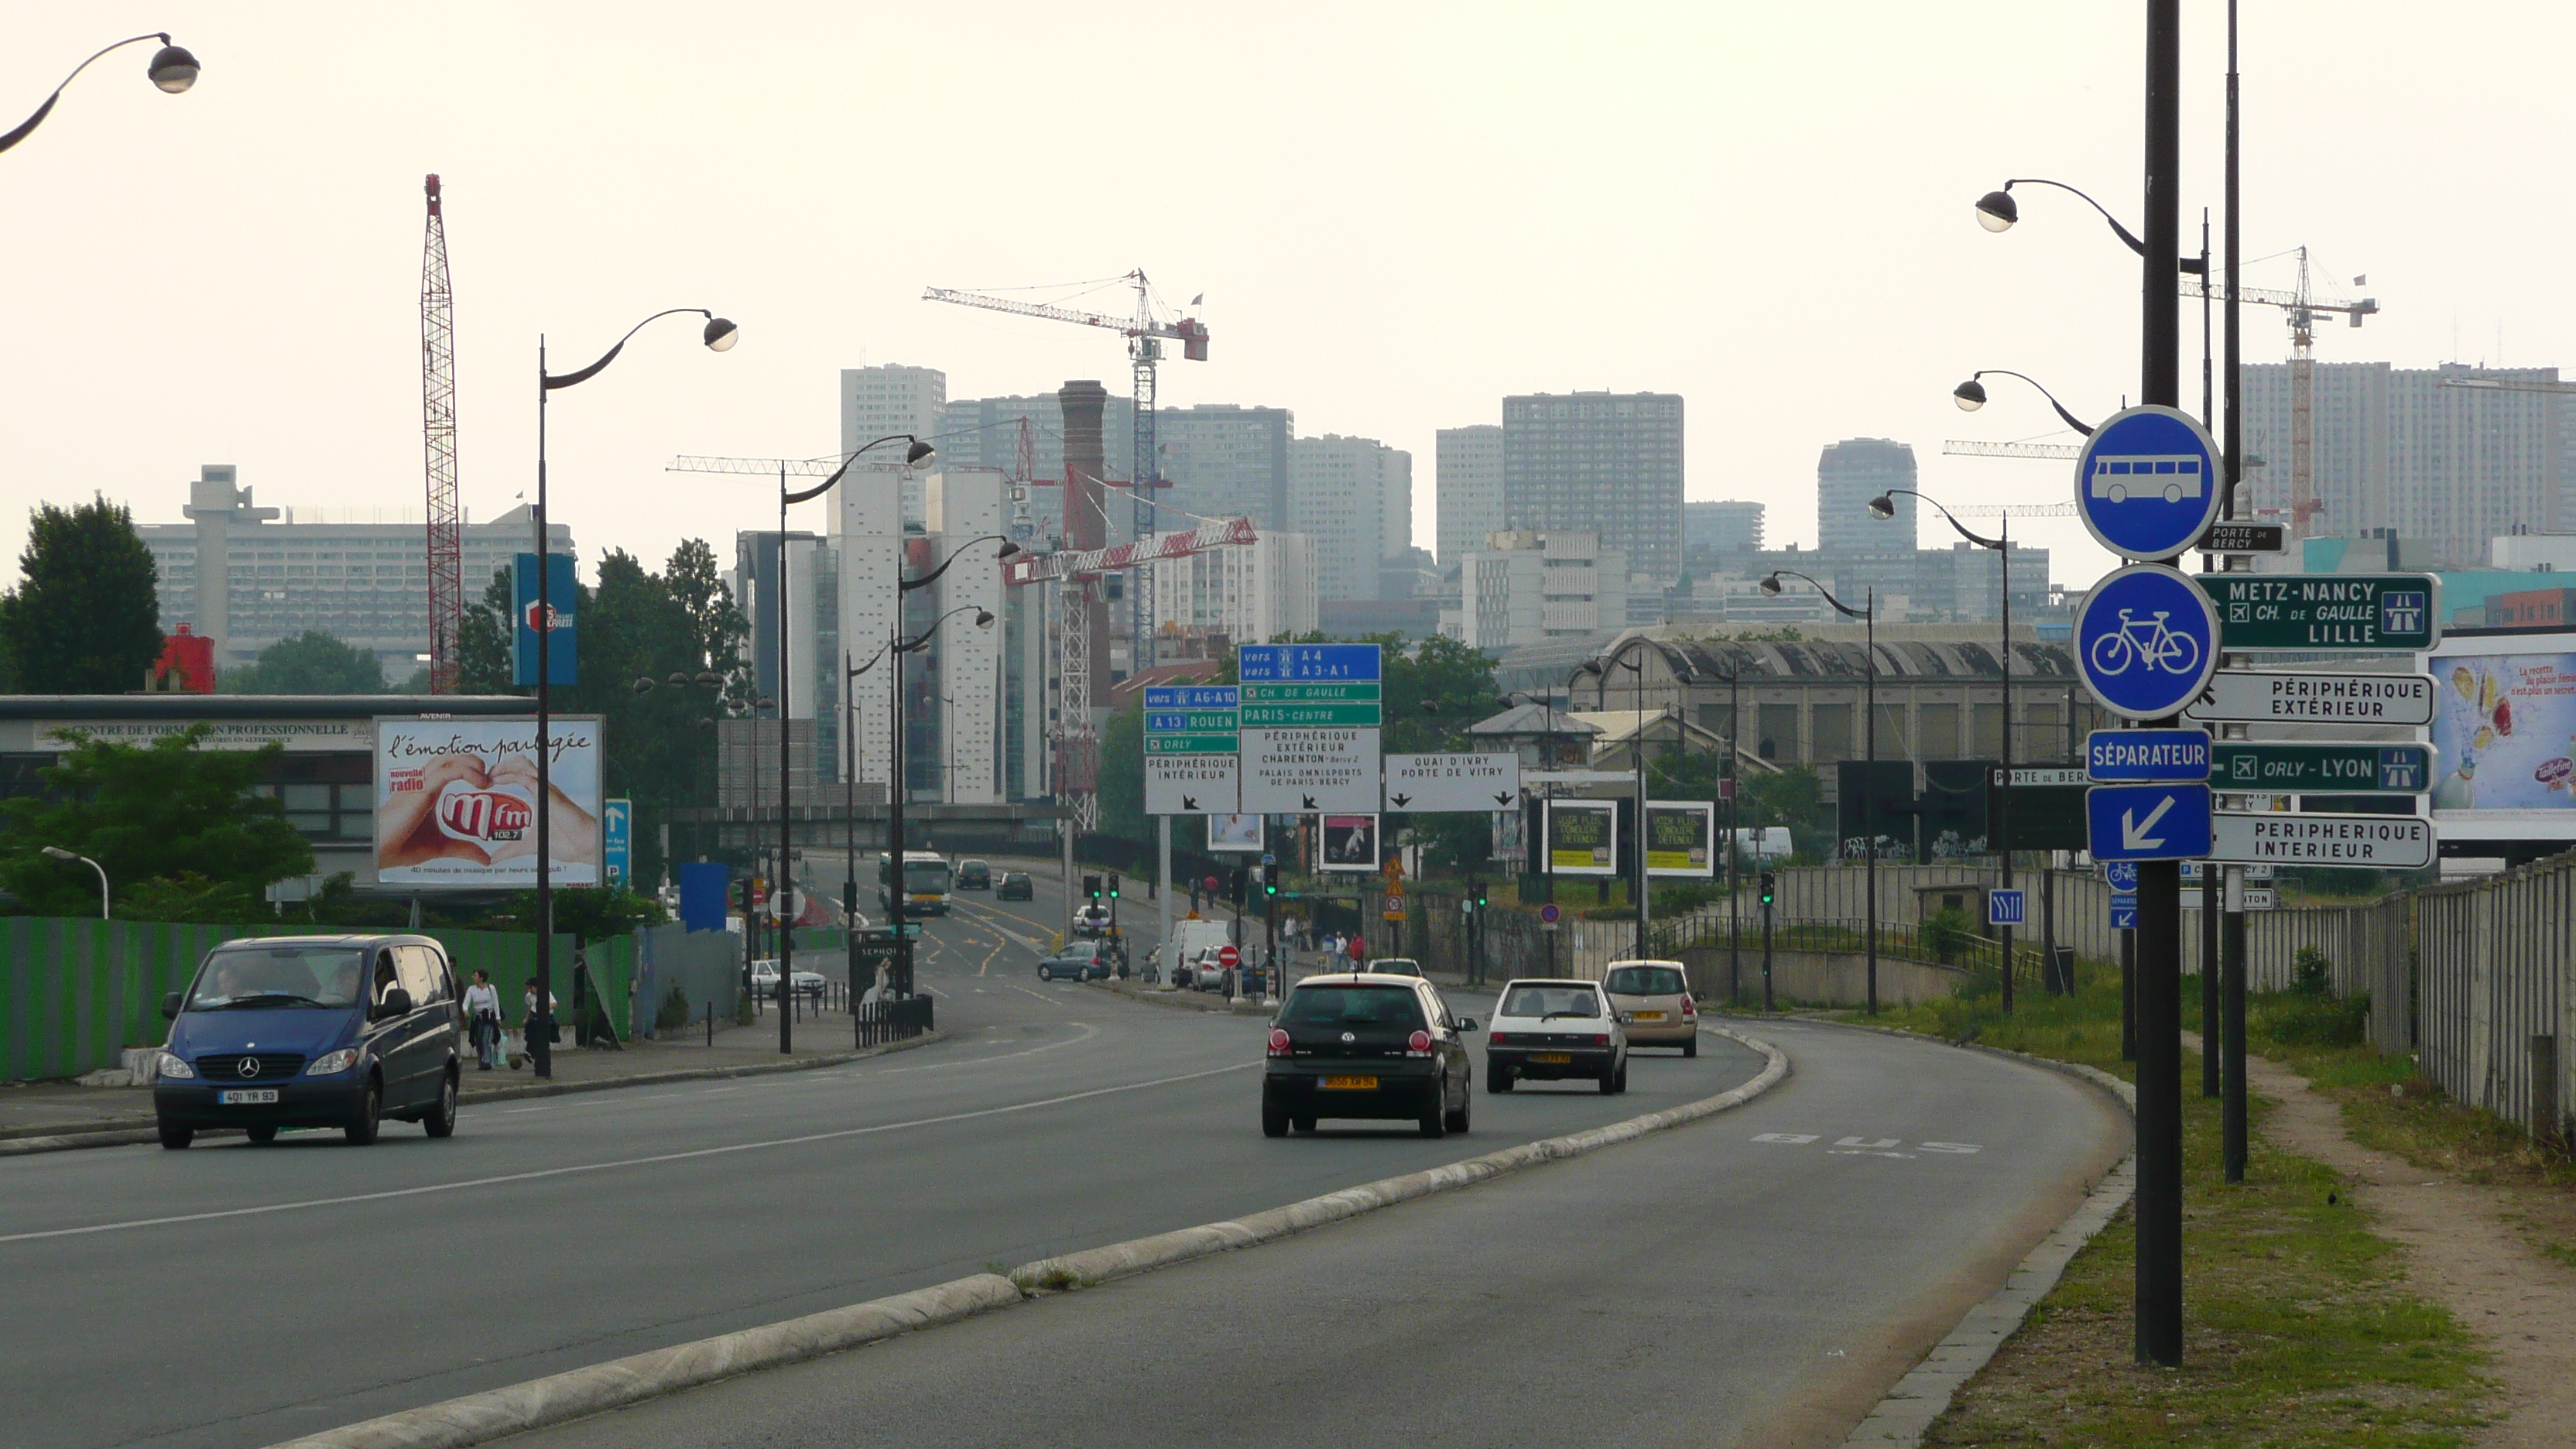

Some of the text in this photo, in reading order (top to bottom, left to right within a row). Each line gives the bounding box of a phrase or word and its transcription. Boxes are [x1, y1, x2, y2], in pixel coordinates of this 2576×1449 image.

[2212, 528, 2251, 538] PORTE
[2212, 539, 2252, 549] BERCY
[2256, 605, 2376, 620] CH. DE GAULLE
[546, 619, 573, 628] XPRESS
[2309, 625, 2376, 643] LILLE
[1245, 653, 1270, 661] vers
[1245, 667, 1270, 676] vers
[2519, 666, 2554, 676] La recette
[2526, 676, 2535, 685] du
[2536, 675, 2557, 687] plaisir
[1285, 688, 1298, 697] DE
[1306, 687, 1346, 697] GAULLE
[2273, 678, 2423, 698] PÉRIPHÉRIQUE
[2528, 685, 2542, 697] plus
[1149, 694, 1170, 703] vers
[2272, 698, 2384, 717] EXTÉRIEUR
[1190, 716, 1232, 727] ROUEN
[128, 725, 146, 735] DE
[148, 724, 224, 735] FORMON
[228, 724, 348, 735] PROFESSIONNELLE
[1265, 731, 1358, 741] PÉRIPHÉRIQUE
[389, 732, 591, 763] l'émotion partgée
[1164, 740, 1191, 749] ORLY
[1277, 742, 1345, 752] EXTÉRIEUR
[2093, 742, 2204, 766] SÉPARATEUR
[1149, 759, 1235, 768] PÉRIPHÉRIQUE
[1415, 756, 1489, 766] QUAI D'IVRY
[1402, 769, 1438, 778] PORTE
[1469, 768, 1503, 776] VITRY
[2264, 762, 2306, 776] ORLY
[2323, 759, 2372, 777] LYON
[390, 769, 423, 779] nouvelle
[1158, 769, 1225, 779] INTÉRIEUR
[1996, 772, 2037, 783] PRTE
[2059, 772, 2089, 782] BER
[391, 778, 424, 793] radio
[2255, 822, 2420, 841] PERIPHERIQUE
[2256, 841, 2373, 858] INTERIEUR
[228, 1091, 275, 1101] 401 YR 93
[1749, 1132, 1984, 1154] BUS
